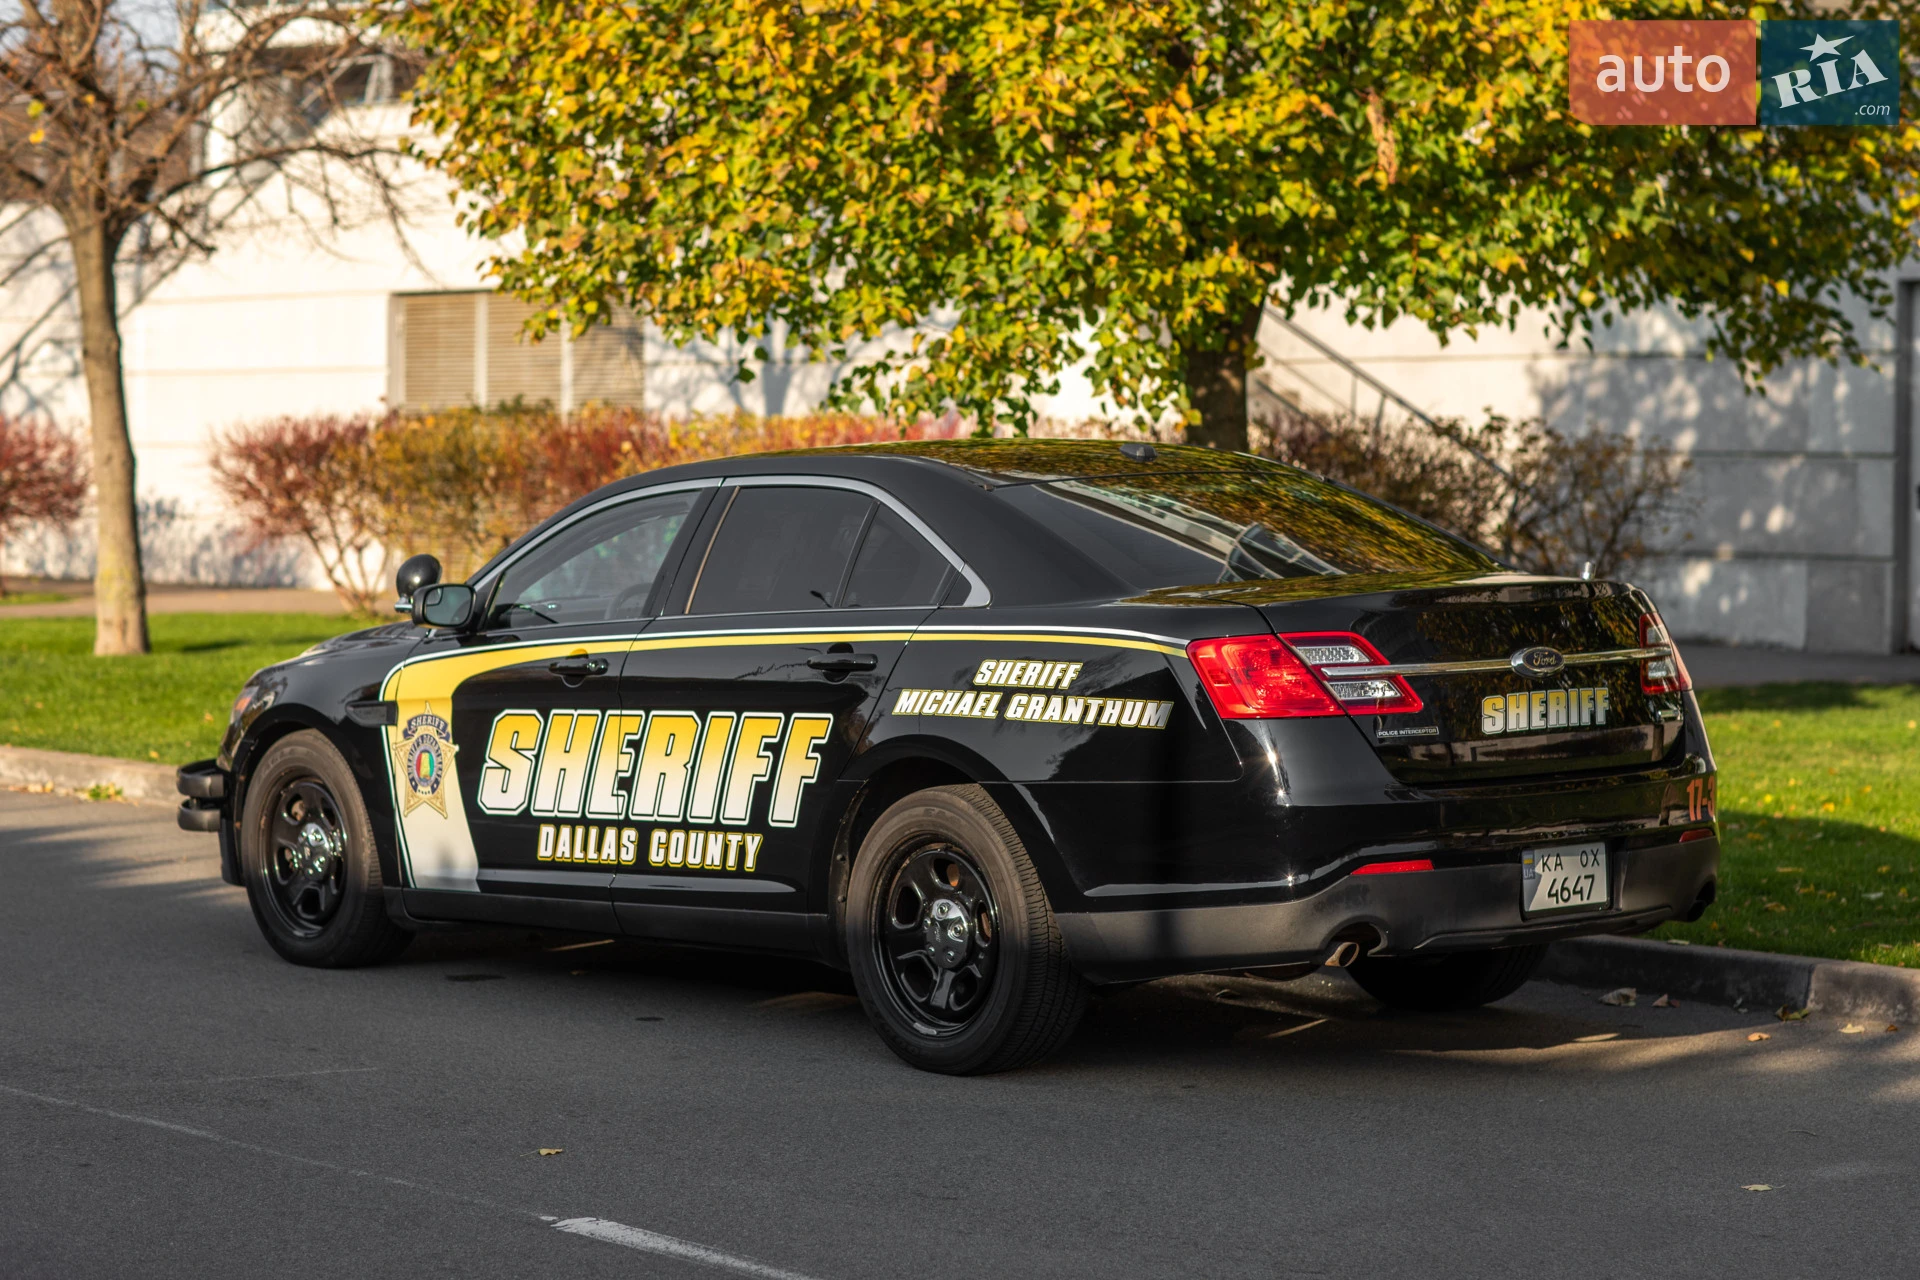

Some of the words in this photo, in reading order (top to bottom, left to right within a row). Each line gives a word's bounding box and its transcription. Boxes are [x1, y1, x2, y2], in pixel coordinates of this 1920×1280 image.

[1533, 651, 1557, 667] Ford
[973, 659, 1083, 690] SHERIFF
[410, 715, 445, 730] SHERIFF
[892, 689, 1003, 719] MICHAEL
[1004, 693, 1174, 729] GRANTHUM
[1481, 687, 1609, 735] SHERIFF
[1400, 727, 1437, 735] INTERCEPTOR
[477, 709, 833, 828] SHERIFF
[537, 824, 639, 865] DALLAS
[649, 829, 763, 872] COUNTY
[1541, 853, 1563, 872] KA
[1580, 848, 1599, 868] OX
[1523, 868, 1534, 878] UA
[1547, 874, 1595, 904] 4647
